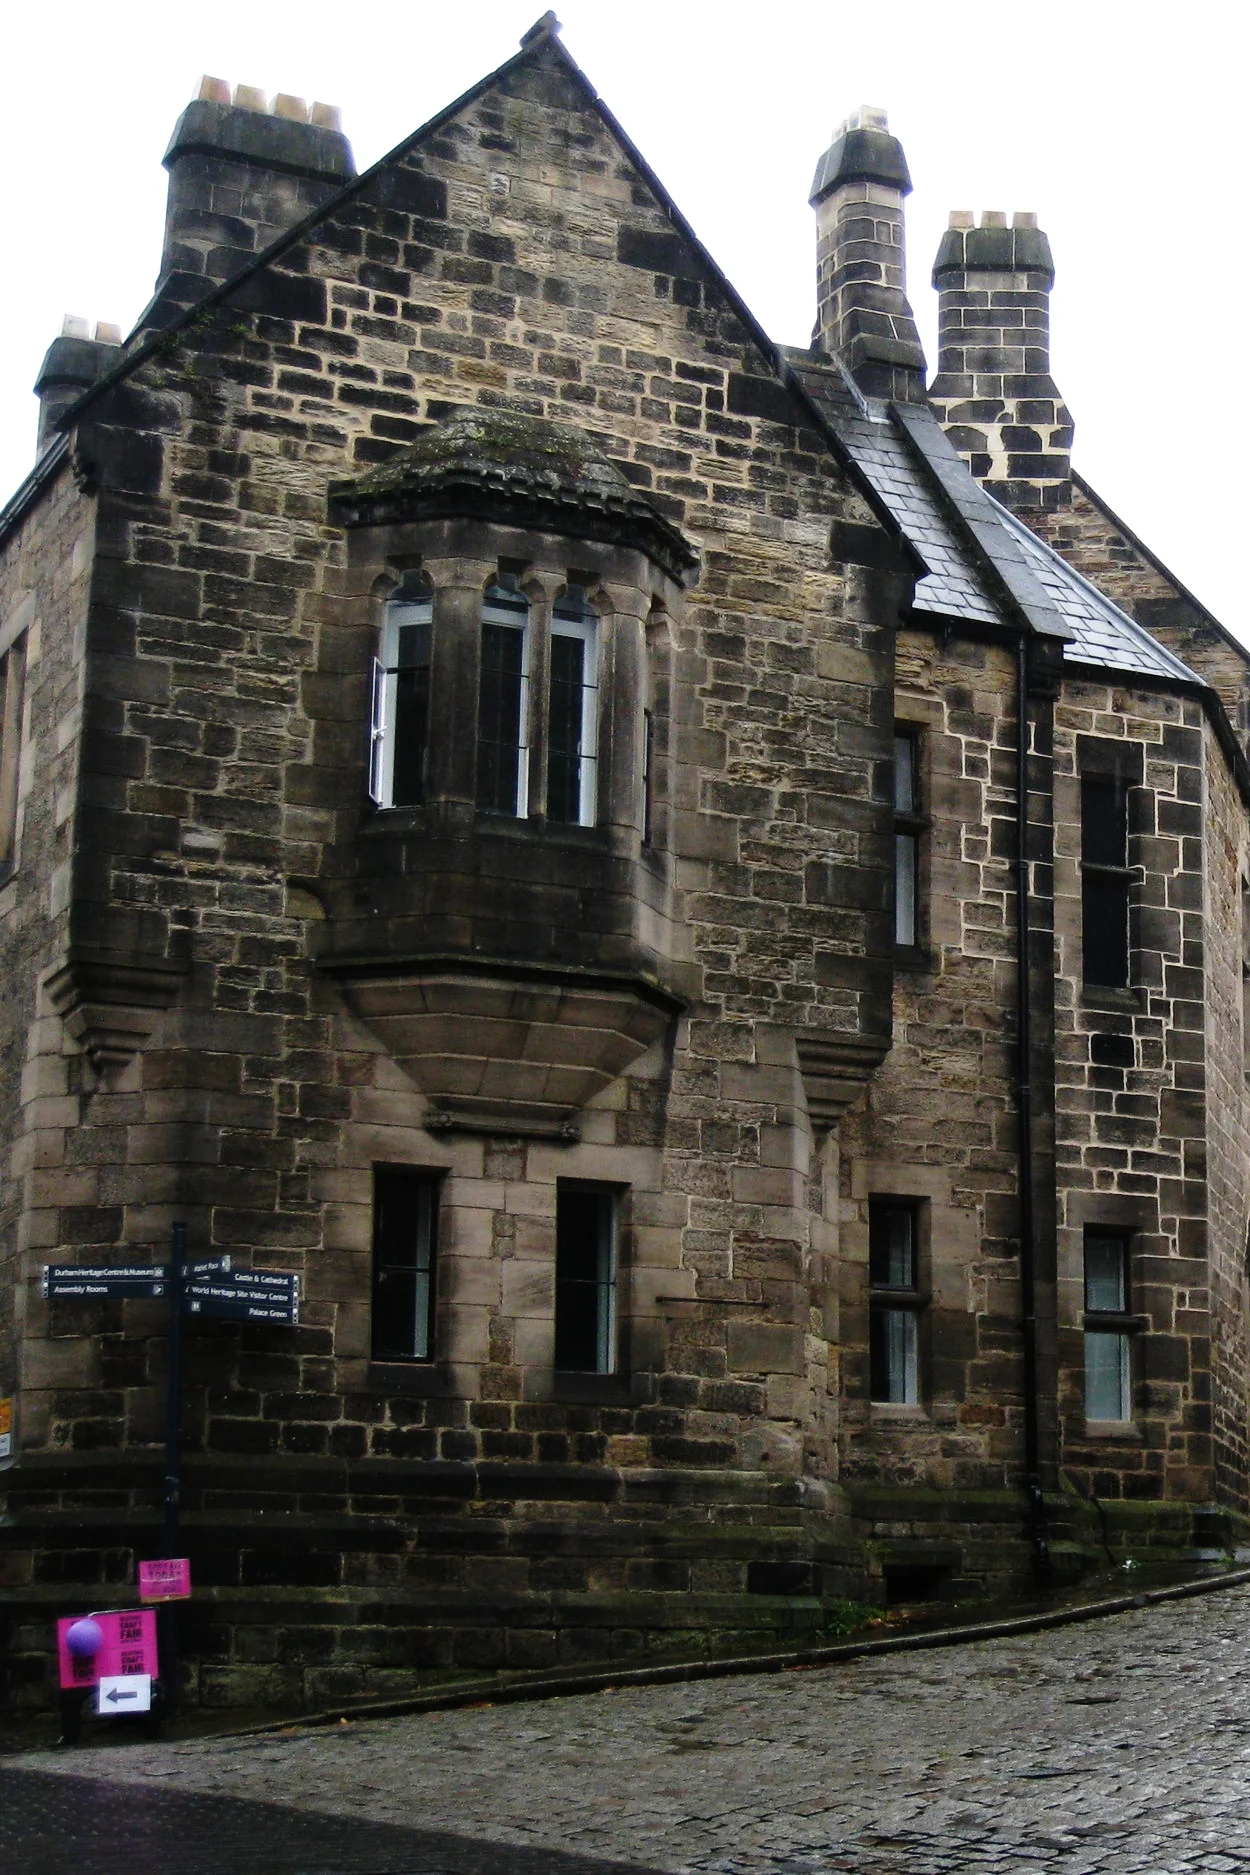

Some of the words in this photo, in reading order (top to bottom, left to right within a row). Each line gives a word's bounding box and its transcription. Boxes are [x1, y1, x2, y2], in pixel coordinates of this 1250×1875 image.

[234, 1273, 254, 1282] Castle
[260, 1275, 289, 1285] Cathedral
[54, 1286, 86, 1295] Assembly
[86, 1285, 109, 1293] Rooms
[191, 1286, 210, 1295] World
[210, 1287, 237, 1298] Heritage
[237, 1290, 249, 1298] Site
[249, 1291, 268, 1300] Visitor
[268, 1292, 289, 1301] Centre
[248, 1307, 269, 1316] Palace
[269, 1309, 288, 1318] Green
[120, 1629, 143, 1640] FAIR
